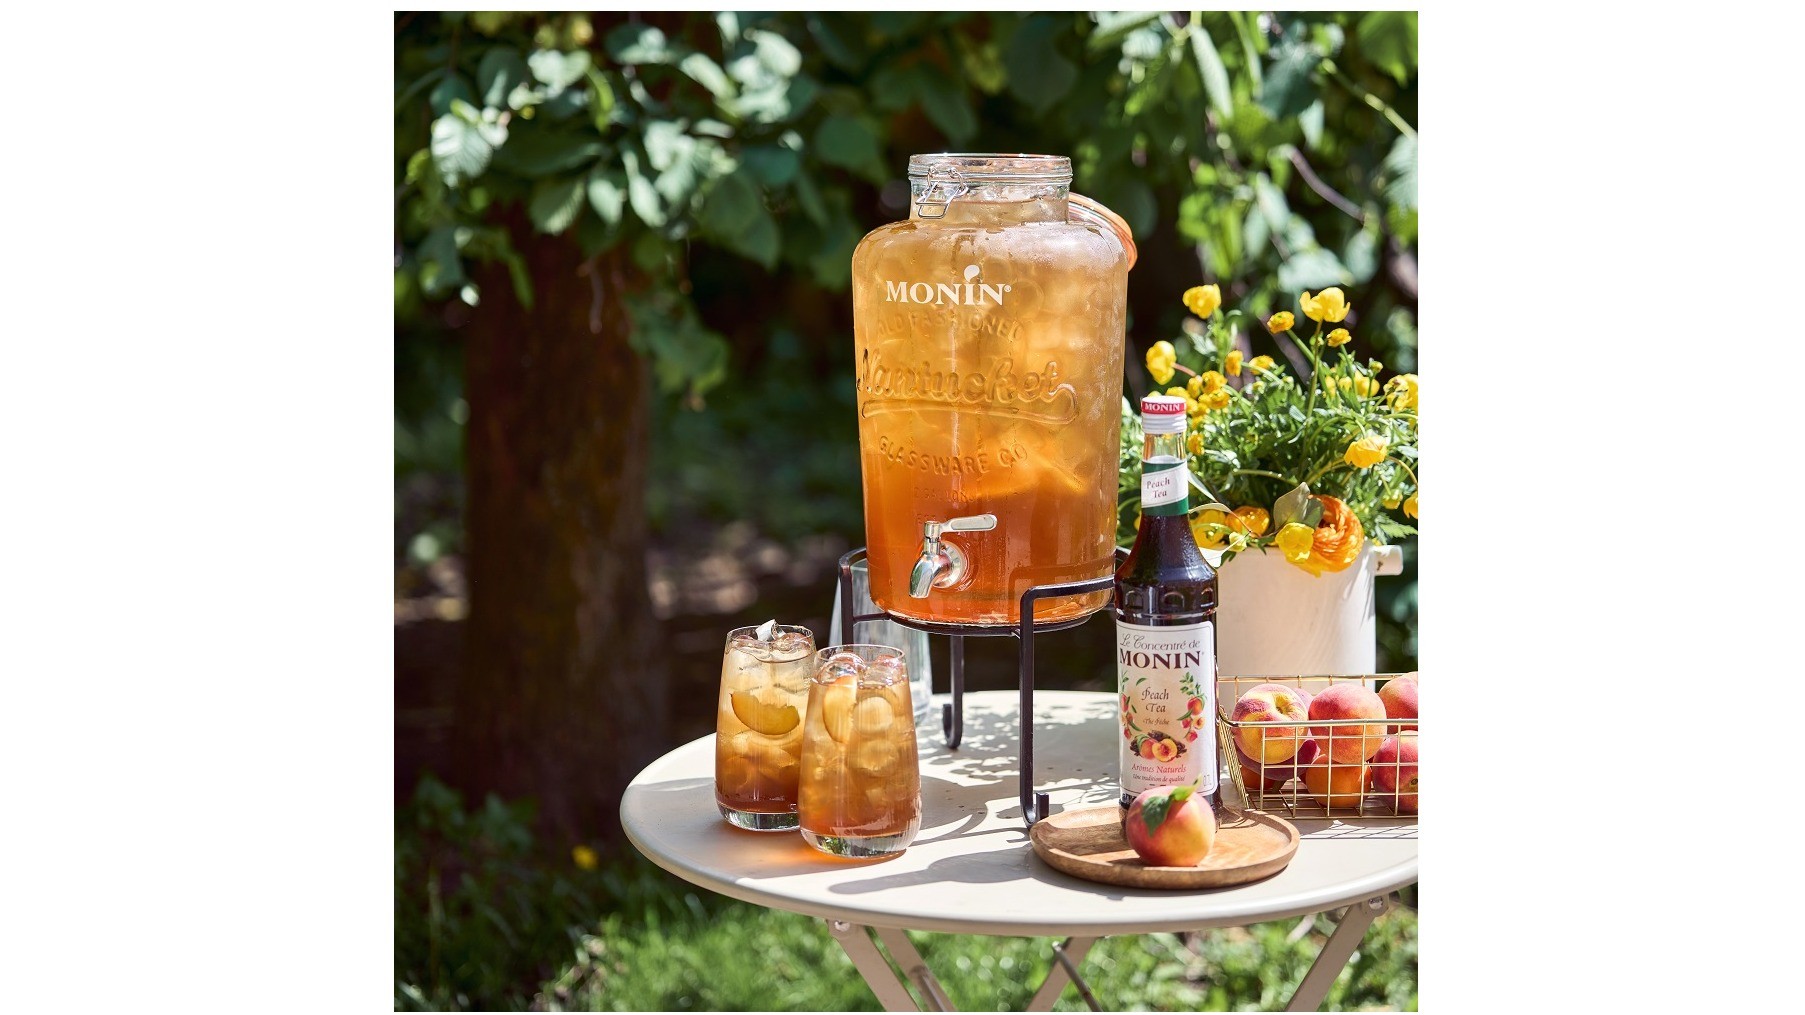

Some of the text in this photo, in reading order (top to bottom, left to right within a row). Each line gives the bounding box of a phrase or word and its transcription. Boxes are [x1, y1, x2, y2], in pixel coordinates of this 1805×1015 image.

[856, 348, 1076, 403] Nantucket
[1144, 402, 1180, 412] MONIN
[879, 435, 991, 475] GLASSWARE
[1146, 477, 1170, 490] Peach
[1152, 490, 1168, 499] Tea
[1120, 633, 1201, 651] Le Concentré de
[1120, 647, 1201, 670] MONIN
[1141, 686, 1169, 701] Peach
[1145, 702, 1166, 713] Tea
[1156, 764, 1187, 774] Naturels
